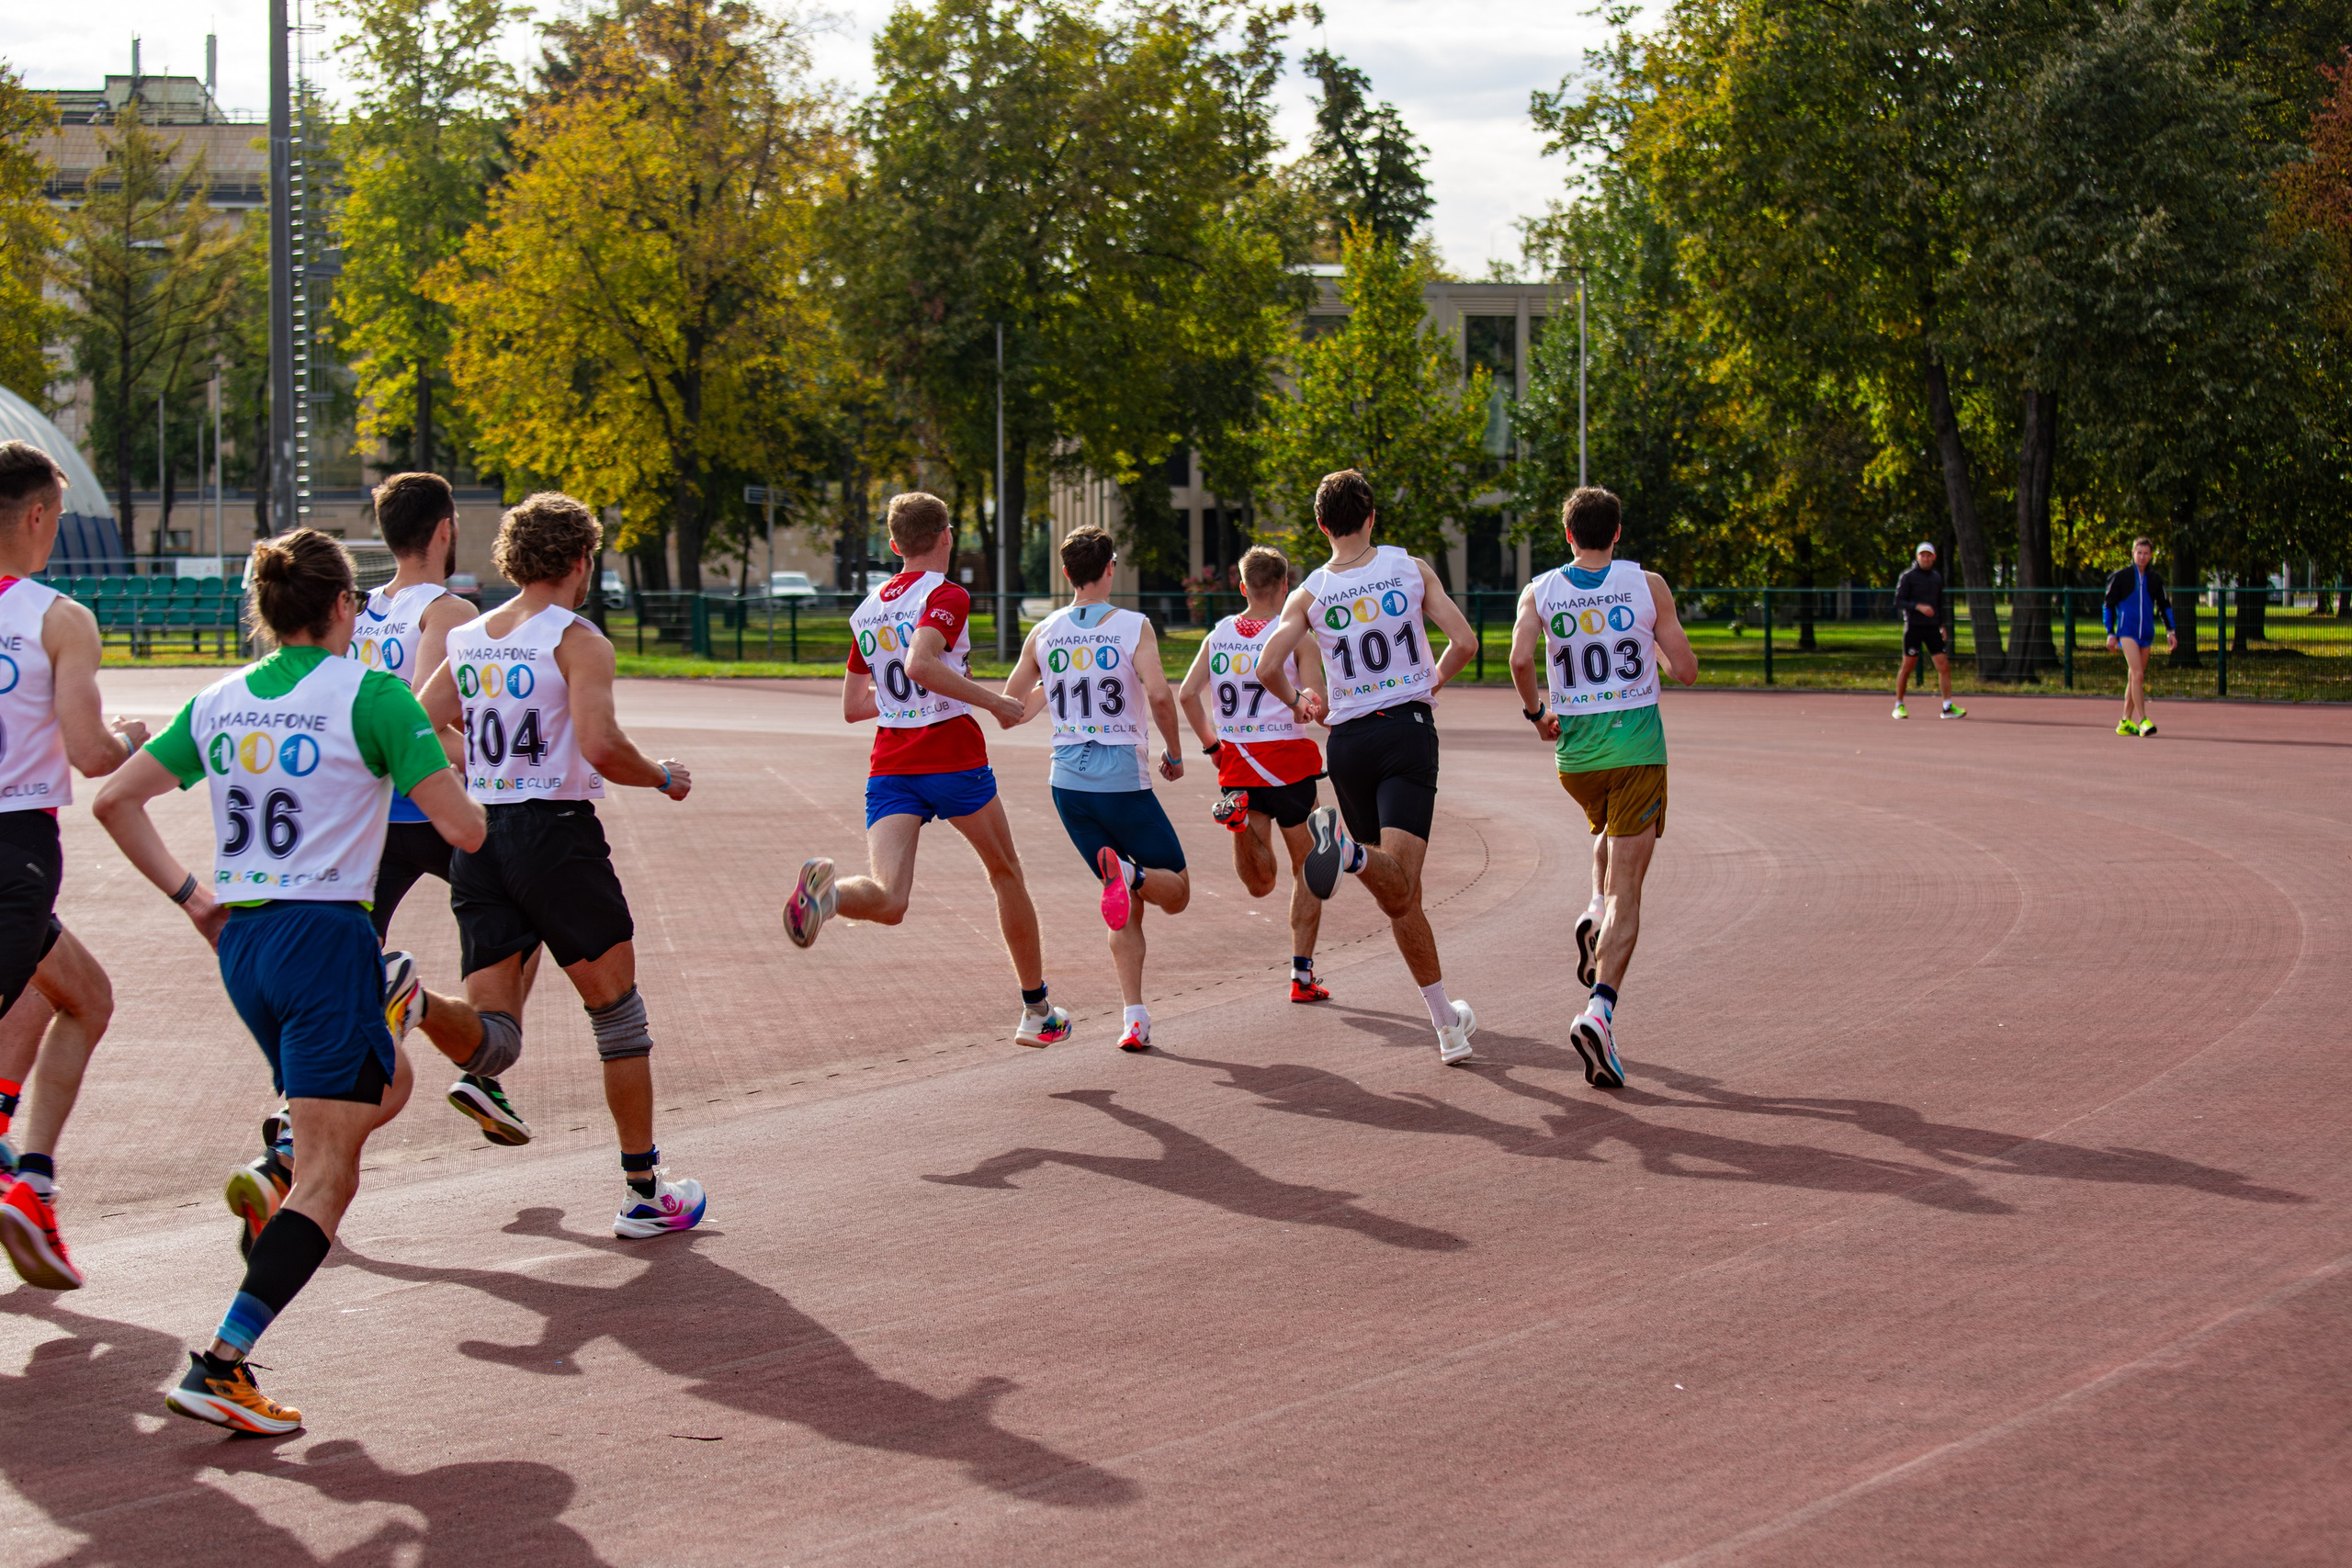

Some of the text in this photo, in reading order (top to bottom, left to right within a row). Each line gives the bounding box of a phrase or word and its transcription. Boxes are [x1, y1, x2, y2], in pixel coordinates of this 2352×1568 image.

[1318, 578, 1403, 607] VMARAFONE
[1548, 592, 1633, 611] VMARAFONE
[458, 648, 538, 661] VMARAFONE
[1047, 635, 1121, 649] VMARAFONE
[1213, 642, 1263, 652] VMARAFO
[1332, 621, 1420, 690] 101
[1554, 637, 1645, 690] 103
[1050, 676, 1125, 722] 113
[1217, 681, 1268, 719] 97
[1560, 685, 1653, 704] VMARAFONE.CLUB
[465, 708, 548, 768] 104
